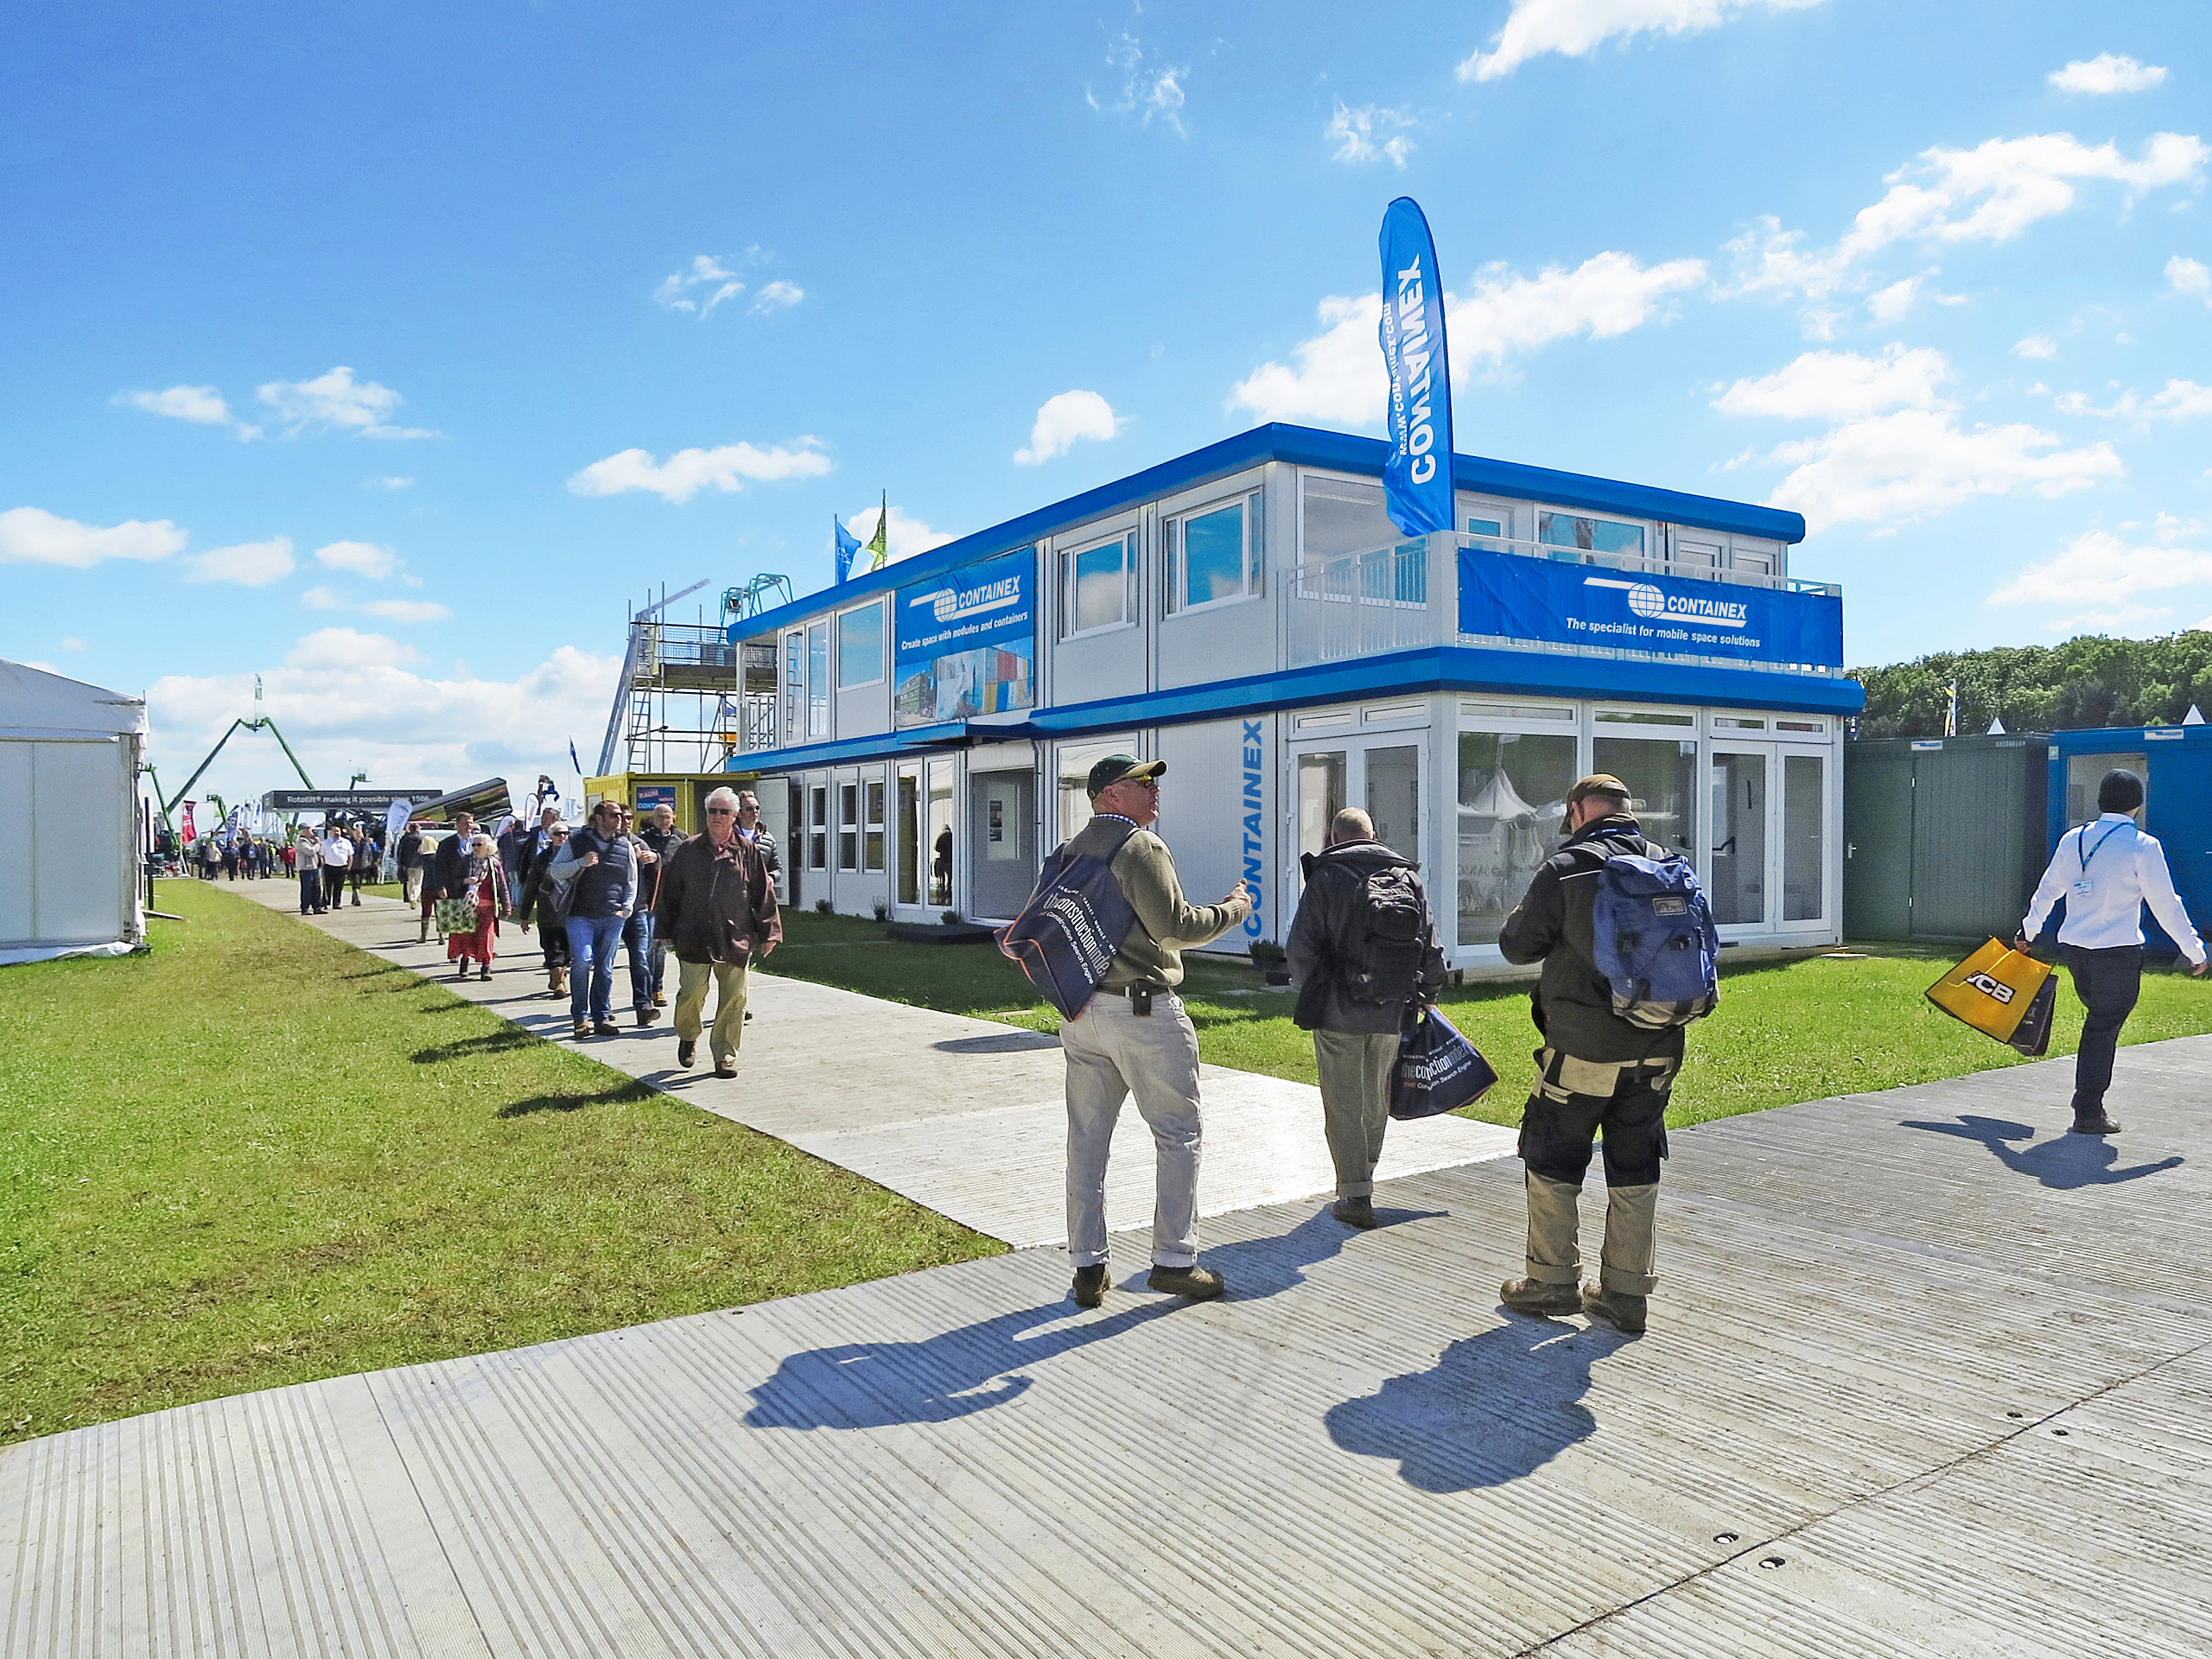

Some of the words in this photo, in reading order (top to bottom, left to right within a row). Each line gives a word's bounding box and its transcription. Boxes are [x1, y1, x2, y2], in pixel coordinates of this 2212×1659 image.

[959, 575, 1021, 609] CONTAINEX
[1667, 596, 1748, 620] CONTAINEX
[901, 639, 921, 651] Create
[922, 634, 938, 648] space
[938, 629, 952, 642] with
[953, 623, 979, 638] modules
[980, 619, 993, 632] and
[994, 611, 1028, 628] containers
[1566, 617, 1586, 630] The
[1589, 621, 1637, 636] specialist
[1639, 625, 1654, 637] for
[1656, 627, 1688, 641] mobile
[1691, 632, 1717, 645] space
[1720, 632, 1761, 648] solutions
[323, 795, 350, 804] making
[359, 795, 390, 804] possible
[1243, 719, 1262, 938] CONTAINEX
[1071, 941, 1084, 963] Search
[1081, 963, 1094, 985] Engine
[1440, 1070, 1458, 1084] Search
